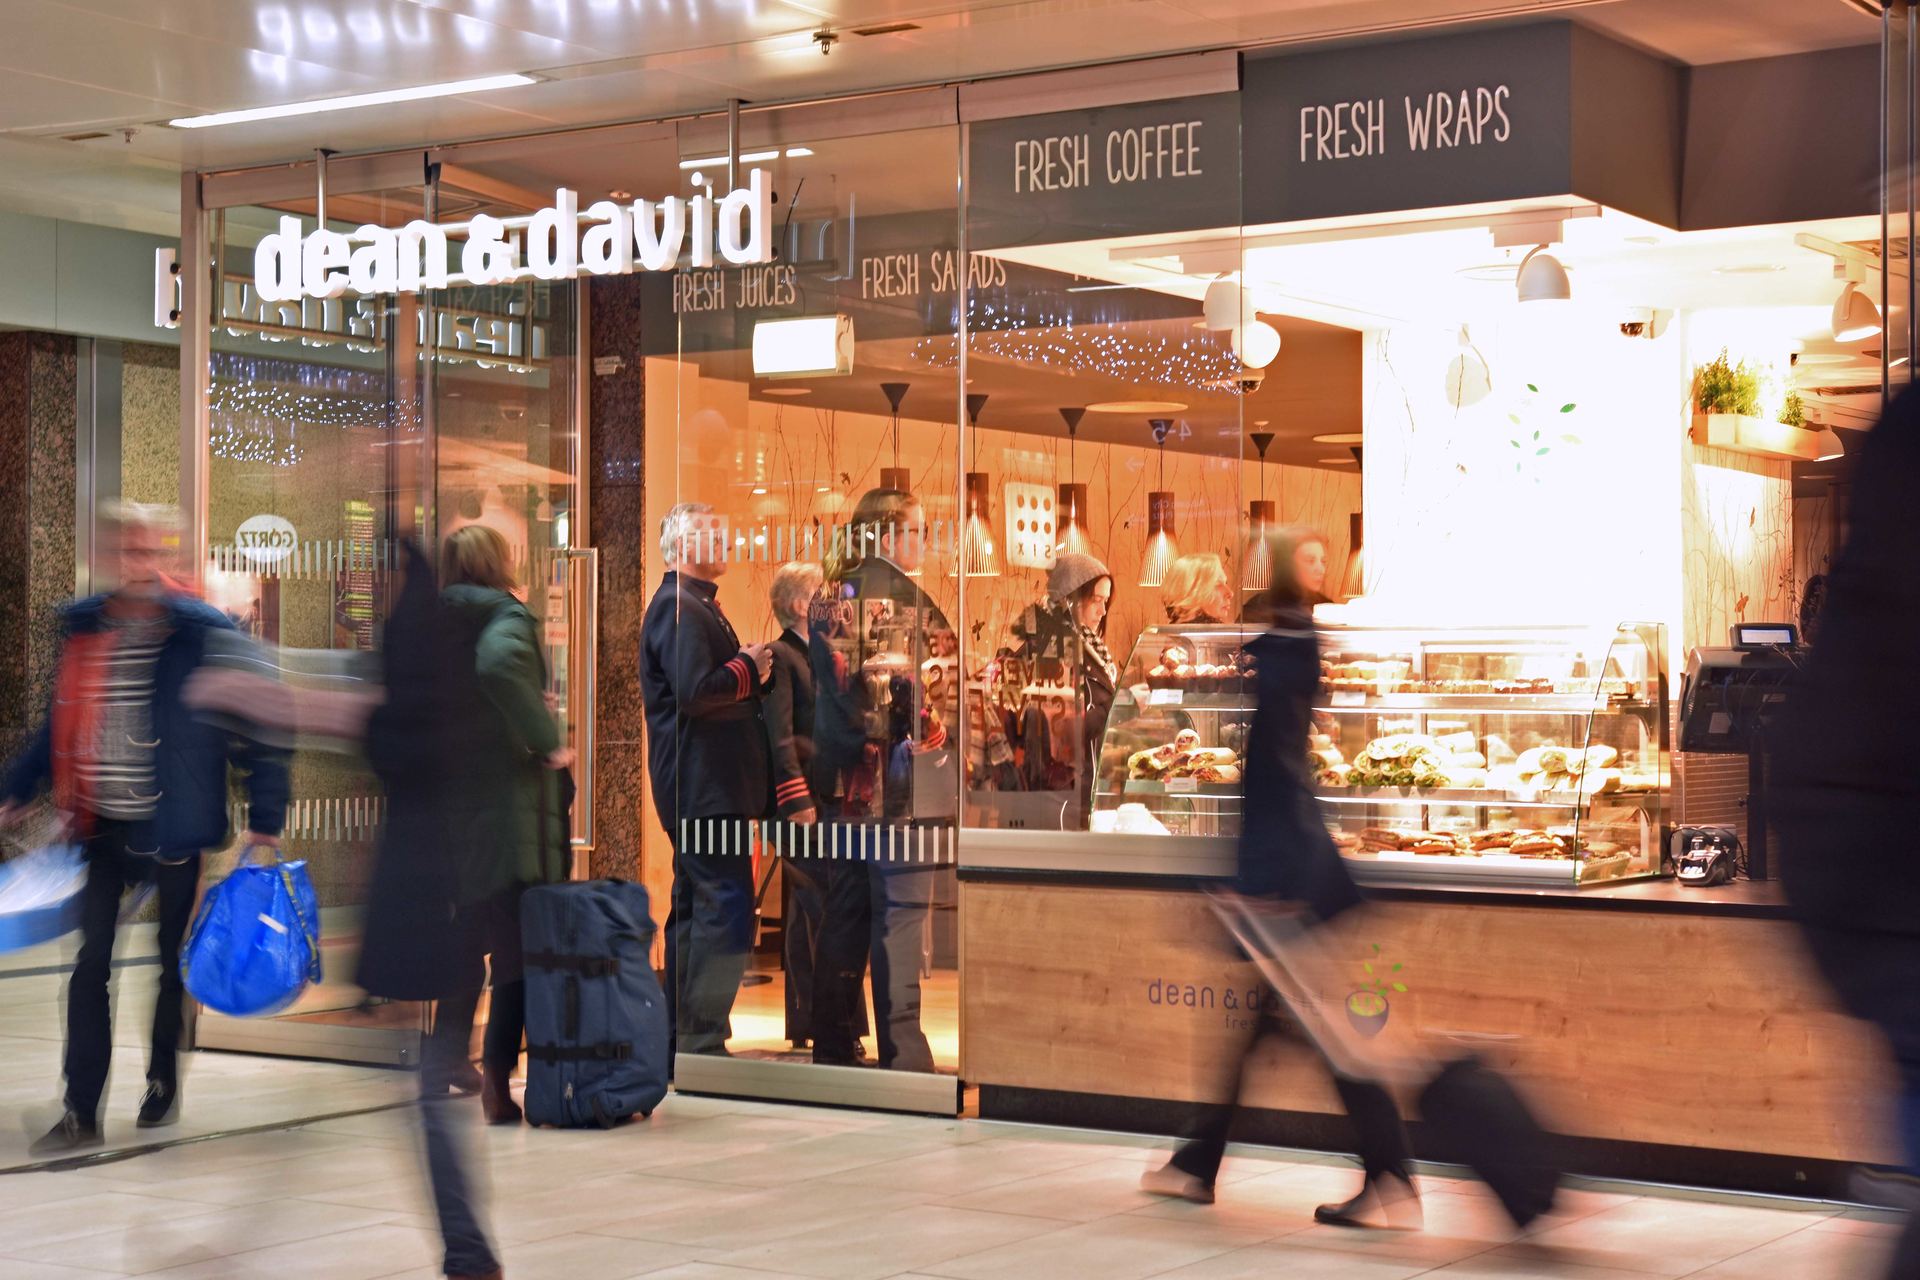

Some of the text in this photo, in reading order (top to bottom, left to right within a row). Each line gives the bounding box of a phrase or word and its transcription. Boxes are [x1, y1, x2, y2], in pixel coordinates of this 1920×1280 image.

[1301, 85, 1510, 162] FRESH WRAPS
[1015, 121, 1203, 193] FRESH COFFEE
[254, 215, 448, 302] dean
[462, 213, 508, 285] &
[527, 168, 772, 281] david
[673, 264, 796, 313] FRESH JUICES
[862, 253, 920, 299] FRESH
[1149, 978, 1214, 1008] dean
[1223, 988, 1239, 1011] &
